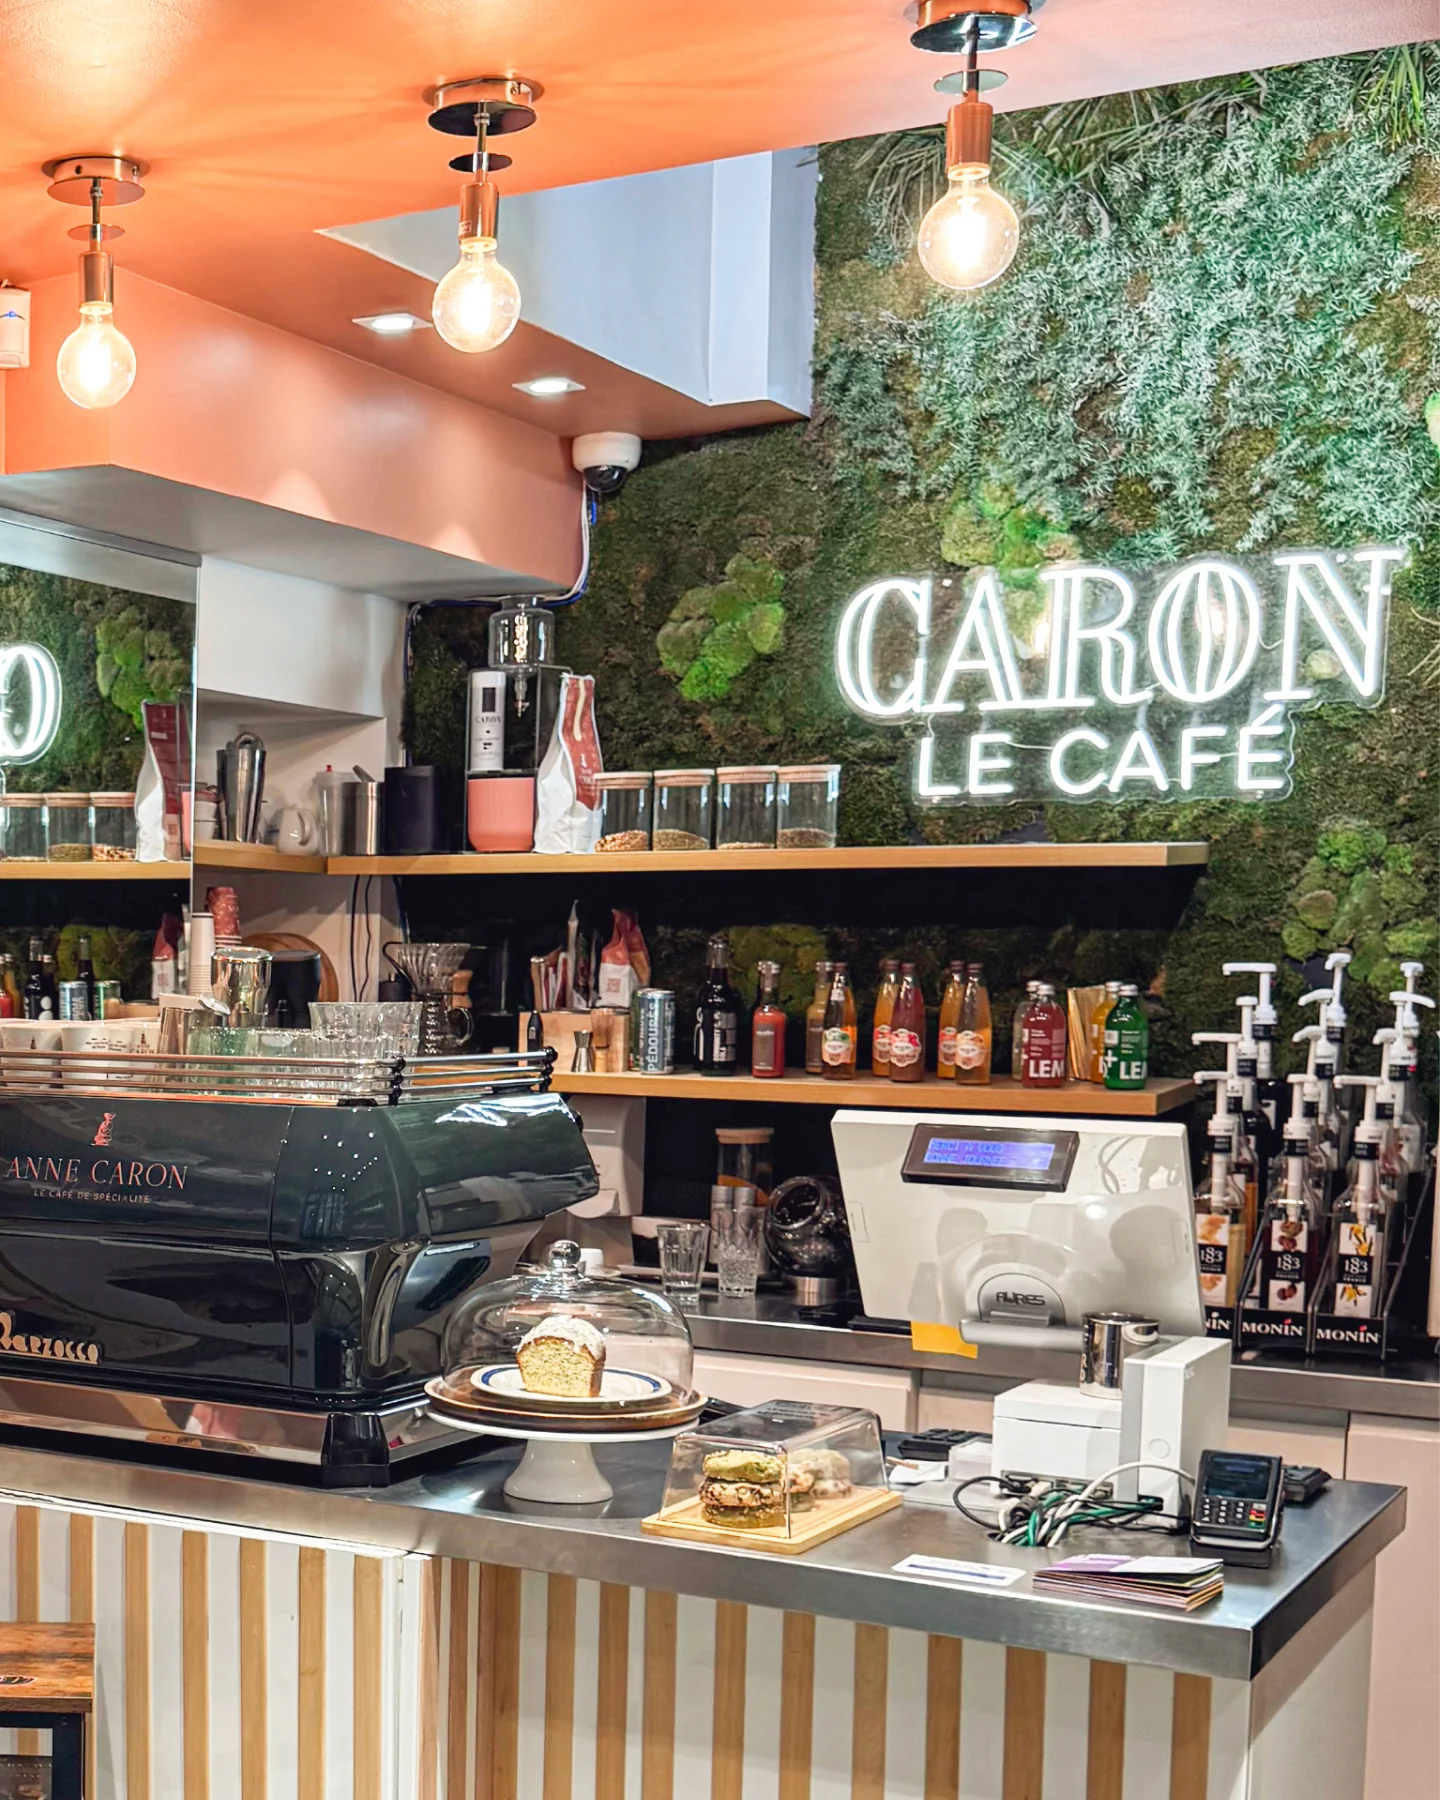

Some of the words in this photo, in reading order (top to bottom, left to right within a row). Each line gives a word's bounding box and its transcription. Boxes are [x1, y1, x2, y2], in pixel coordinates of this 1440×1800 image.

[836, 547, 1405, 716] CARON
[475, 715, 502, 724] CARON
[918, 732, 1014, 796] LE
[1049, 702, 1286, 796] CAFÉ
[4, 1155, 81, 1184] ANNE
[90, 1158, 188, 1191] CARON
[33, 1188, 46, 1198] LE
[48, 1188, 73, 1199] CAFÉ
[77, 1191, 90, 1200] DE
[995, 1290, 1047, 1306] AURES
[1205, 1311, 1231, 1331] NIN
[1242, 1318, 1304, 1337] MONIN
[1316, 1324, 1380, 1345] MONIN
